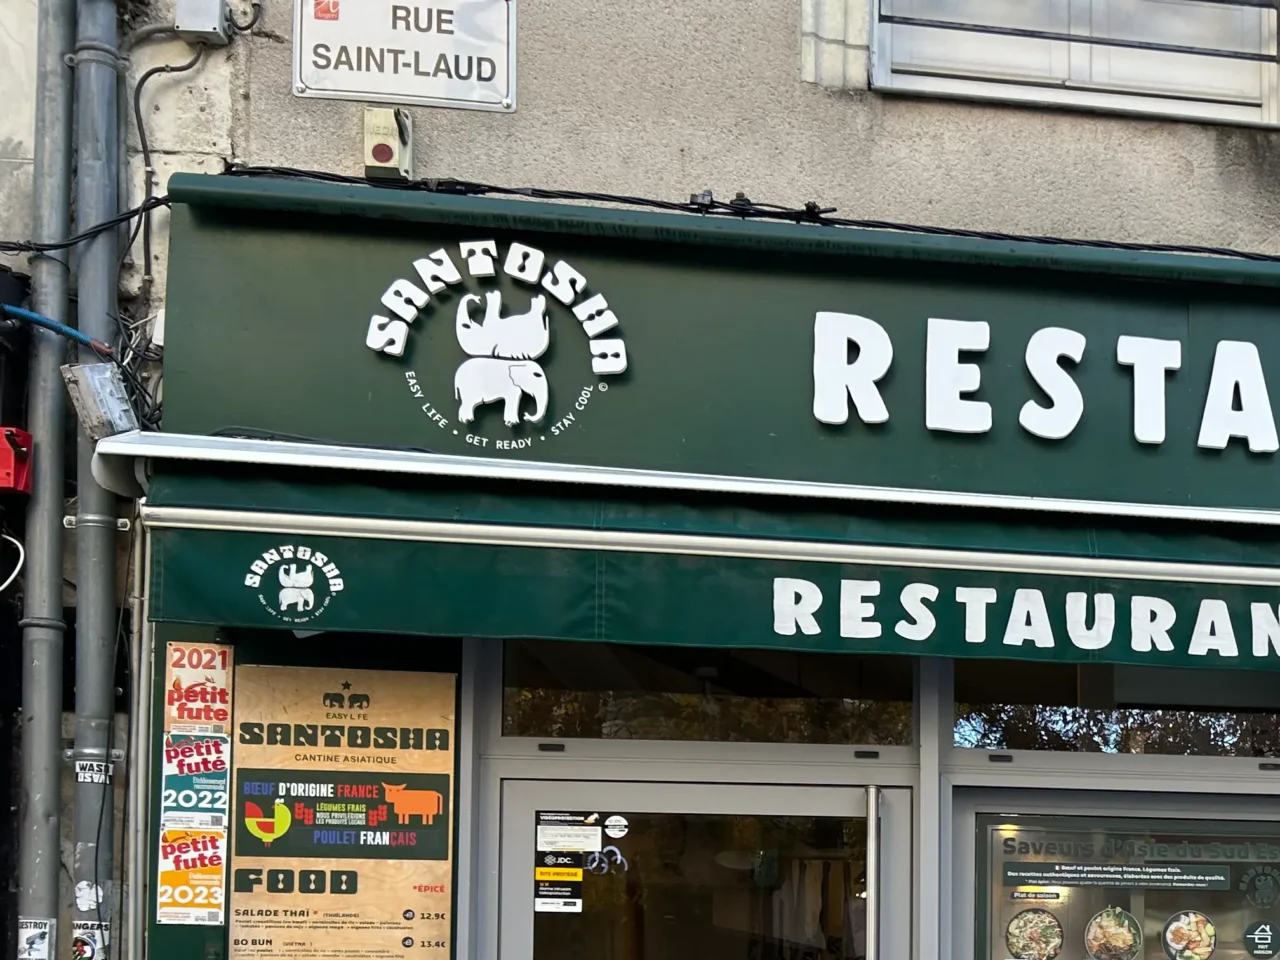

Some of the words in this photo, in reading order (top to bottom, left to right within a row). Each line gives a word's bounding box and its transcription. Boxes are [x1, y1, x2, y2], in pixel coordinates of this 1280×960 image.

[392, 5, 454, 35] RUE
[312, 43, 496, 82] SAINT-LAUD
[366, 240, 628, 375] SANTOSHA
[405, 371, 424, 398] EASY
[422, 402, 448, 429] LIFE
[466, 434, 488, 448] GET
[496, 437, 532, 450] READY
[551, 414, 576, 436] STAY
[575, 384, 593, 410] COOL
[244, 545, 344, 592] SANTOSHA
[171, 648, 227, 670] 2021
[167, 686, 229, 706] petit
[326, 712, 350, 720] EASY
[239, 723, 449, 751] SANTOSHA
[165, 739, 223, 764] petit
[294, 753, 340, 763] CANTINE
[343, 755, 397, 765] ASIATIQUE
[176, 756, 226, 776] futé
[163, 790, 227, 808] 2022
[279, 783, 334, 797] D'ORIGINE
[337, 785, 379, 798] FRANCE
[316, 802, 346, 812] LÉGUMES
[347, 804, 366, 812] FRAIS
[161, 835, 220, 859] petit
[314, 831, 356, 844] POULET
[360, 831, 417, 846] FRANÇAIS
[173, 852, 222, 871] futé
[234, 868, 358, 895] FOOD
[160, 885, 223, 904] 2023
[234, 909, 279, 917] SALADE
[283, 909, 309, 917] THAÏ
[420, 912, 446, 920] 12.9€
[420, 940, 446, 948] 13.4€
